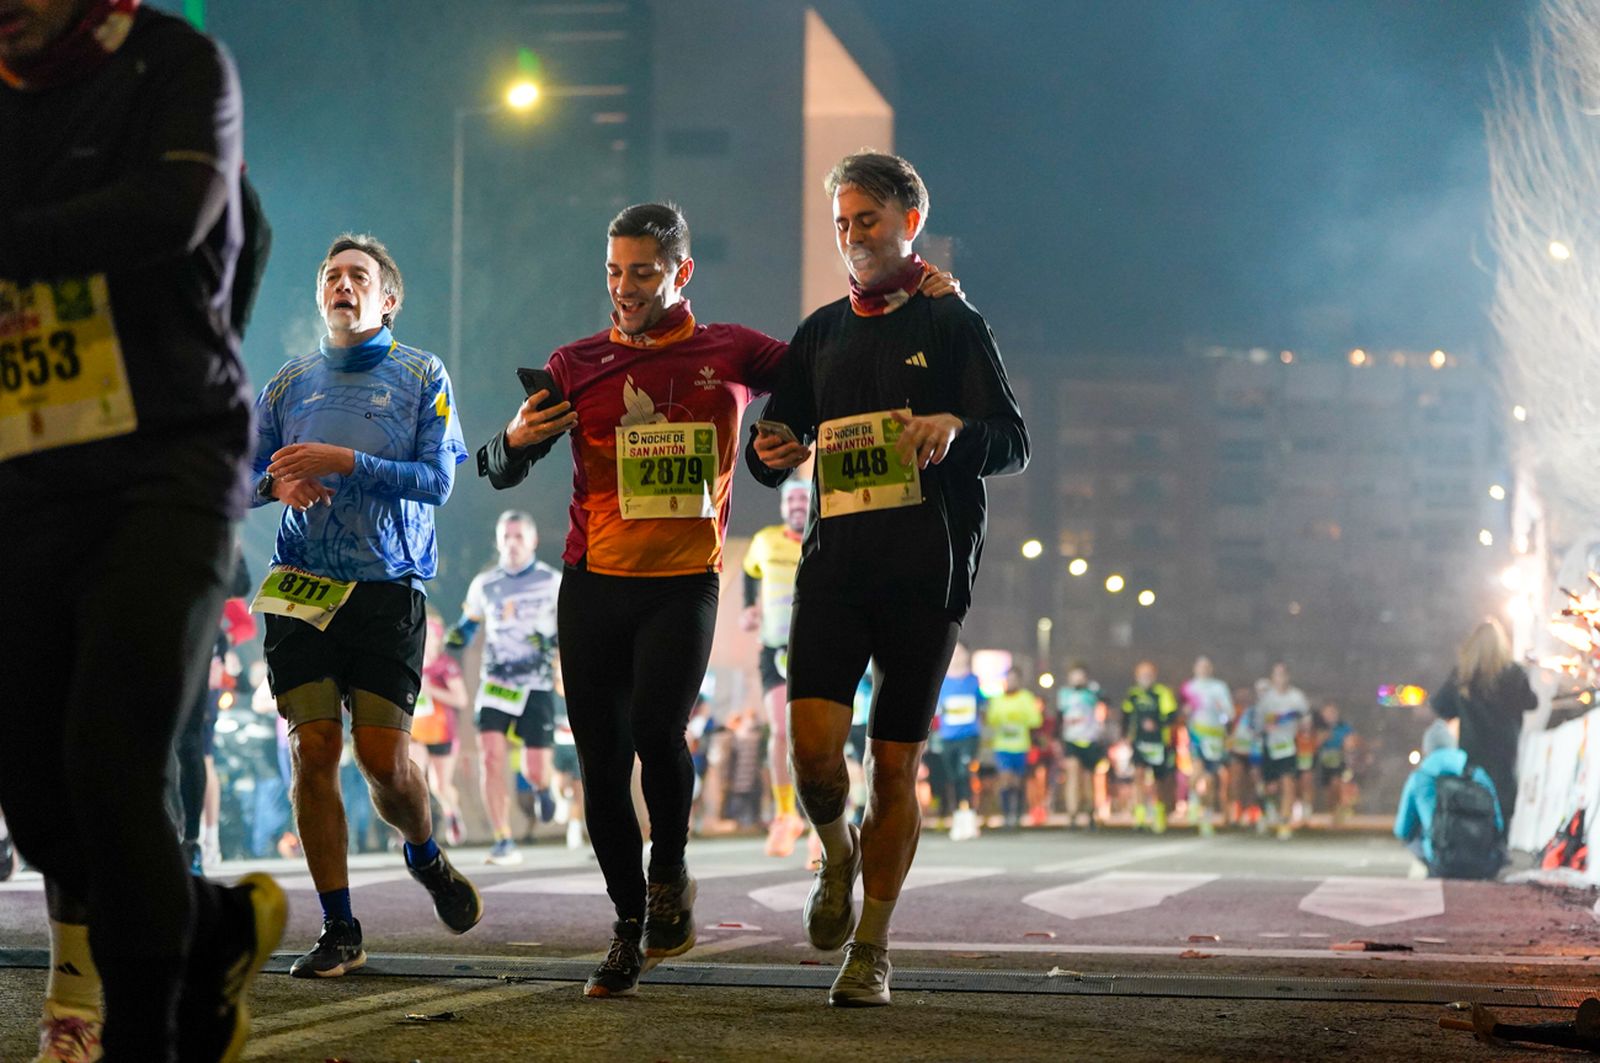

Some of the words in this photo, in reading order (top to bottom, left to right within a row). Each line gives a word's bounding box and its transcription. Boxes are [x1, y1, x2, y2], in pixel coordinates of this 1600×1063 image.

[640, 434, 672, 445] NOCHE
[673, 433, 685, 443] DE
[834, 427, 859, 440] NOCHE
[861, 425, 873, 434] DE
[629, 446, 650, 458] SAN
[826, 442, 842, 454] SAN
[842, 447, 888, 479] 448
[640, 457, 703, 486] 2879
[278, 572, 331, 601] 8711
